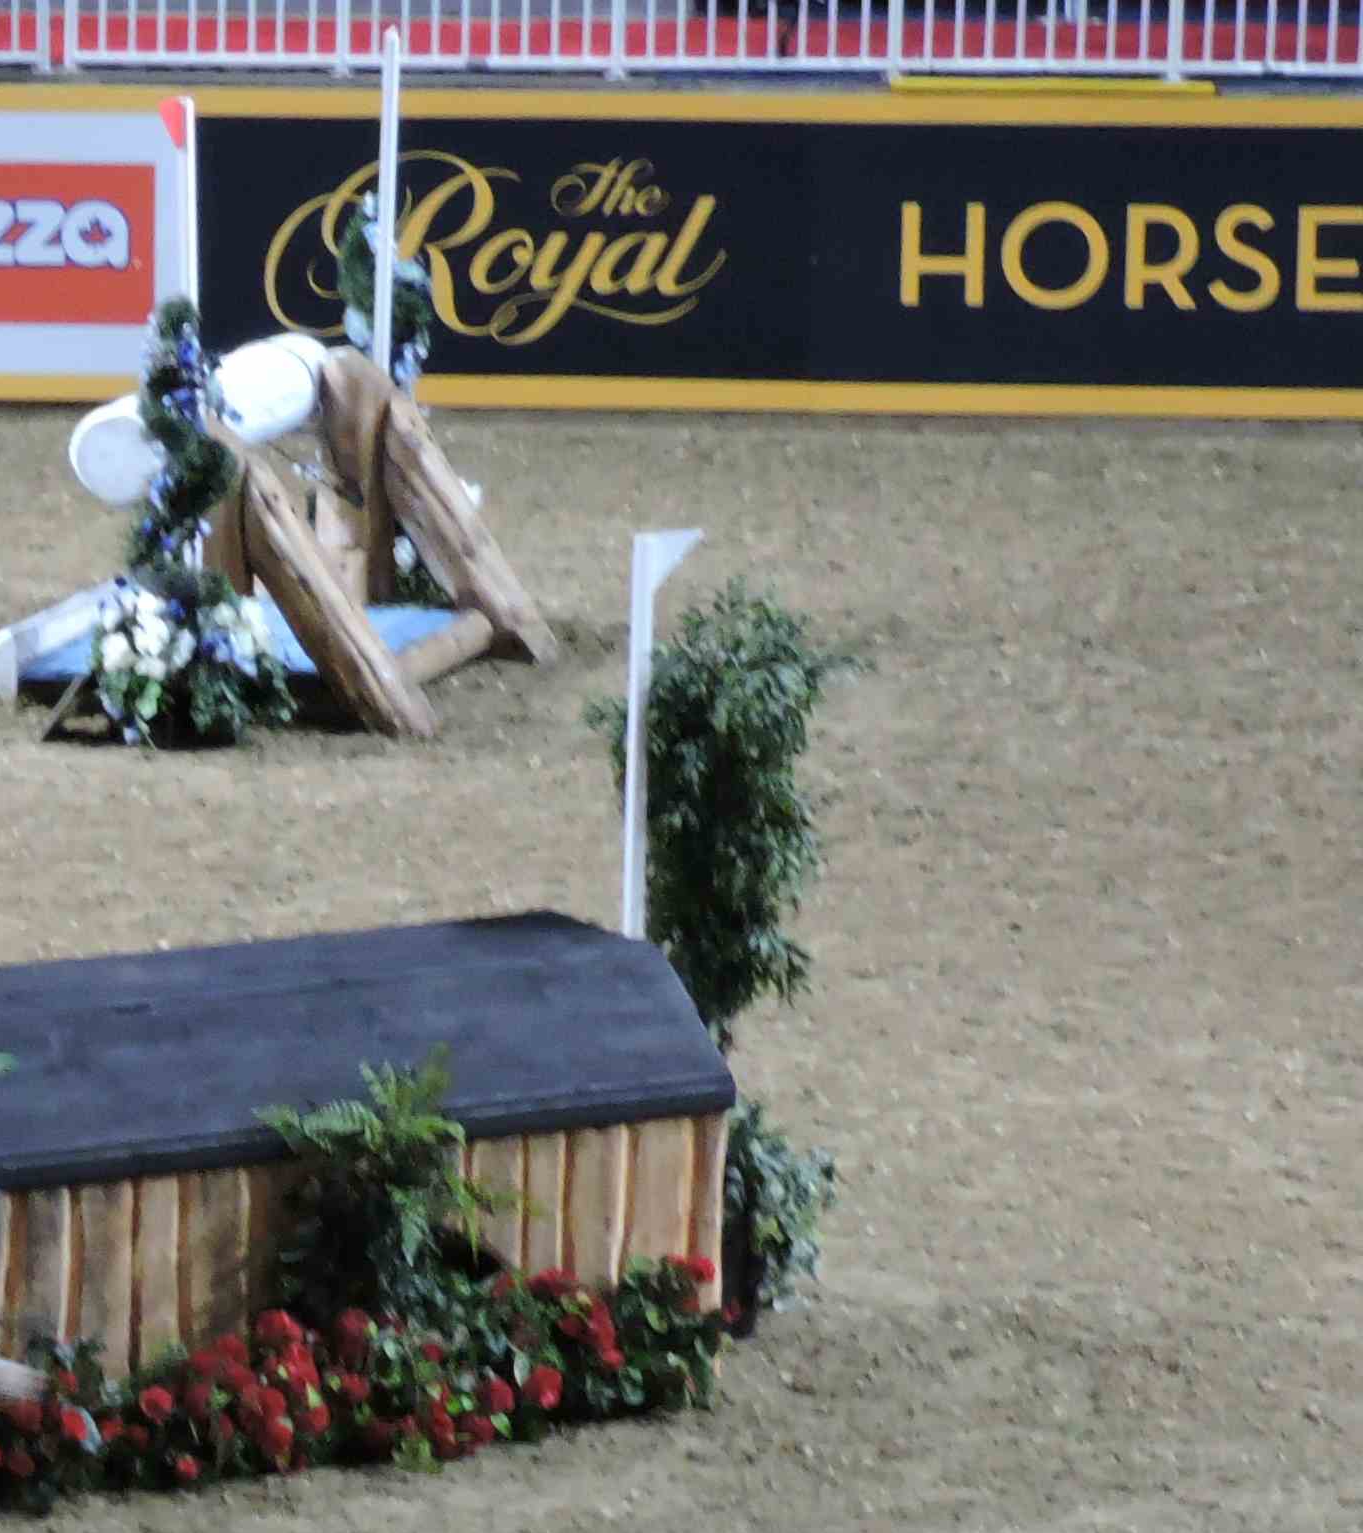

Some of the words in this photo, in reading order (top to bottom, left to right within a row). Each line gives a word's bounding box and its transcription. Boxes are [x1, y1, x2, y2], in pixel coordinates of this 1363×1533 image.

[550, 157, 672, 218] The
[264, 149, 728, 347] Royal
[899, 200, 1363, 312] HORSE
